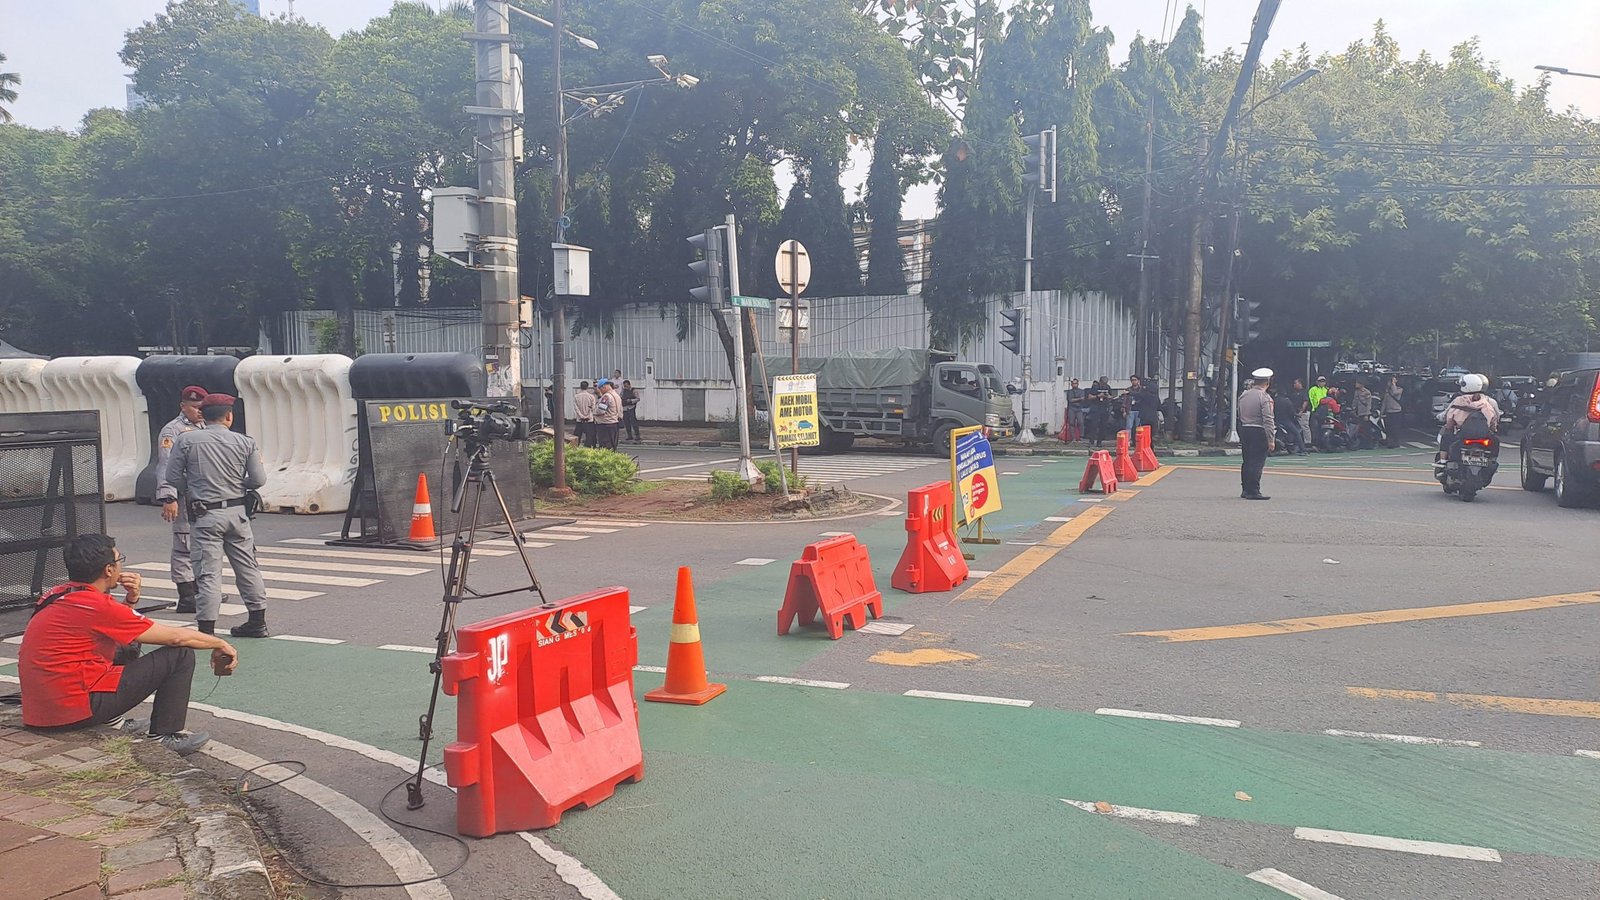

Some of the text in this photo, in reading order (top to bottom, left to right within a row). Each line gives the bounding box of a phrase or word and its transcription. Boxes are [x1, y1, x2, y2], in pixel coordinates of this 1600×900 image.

[780, 394, 813, 406] NAEK MOBIL
[379, 403, 448, 422] POLISI
[779, 406, 813, 418] AME MOTOR
[973, 451, 987, 462] ARUS
